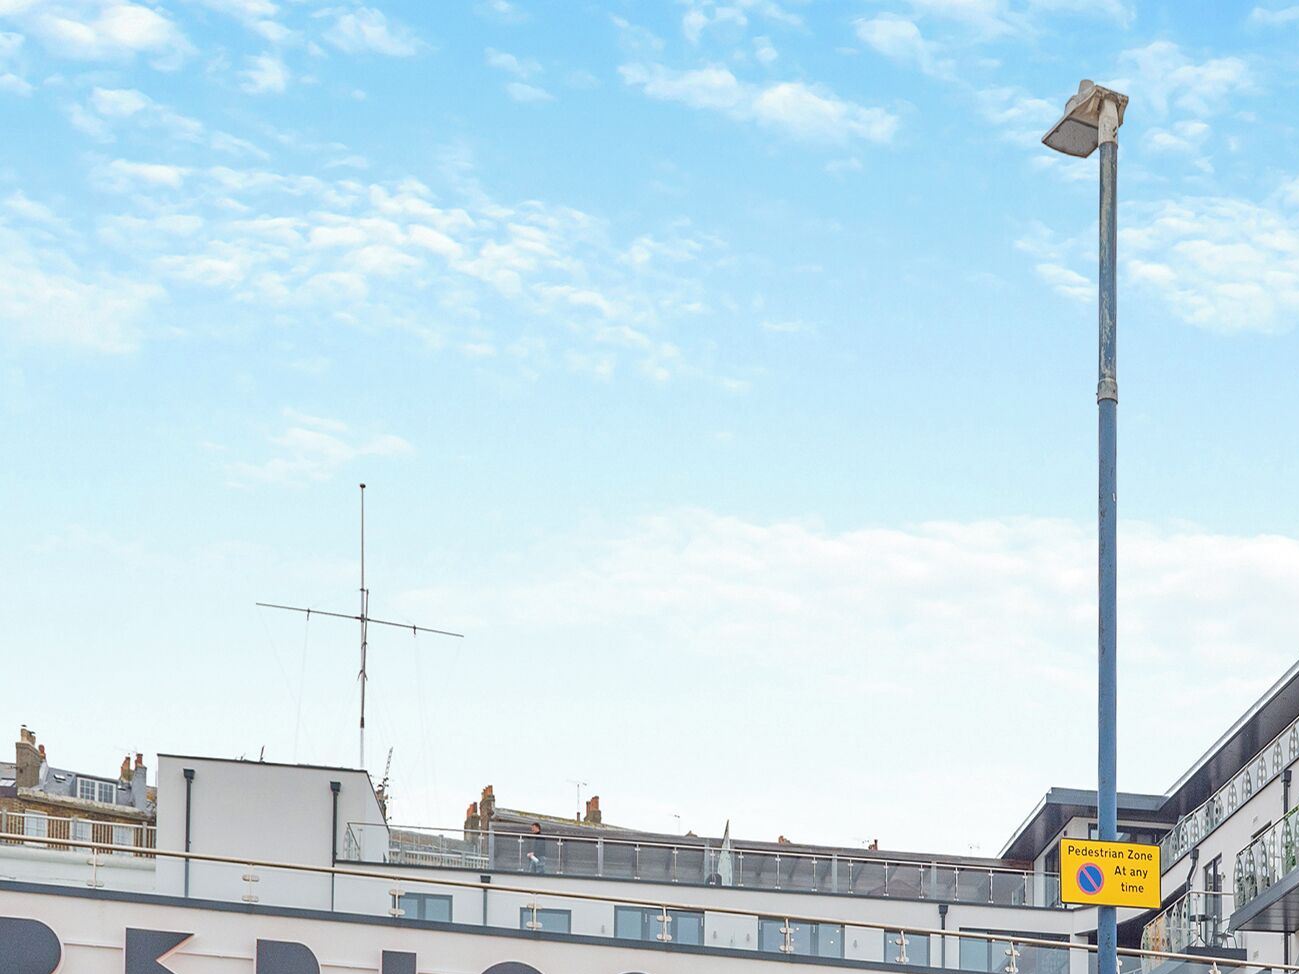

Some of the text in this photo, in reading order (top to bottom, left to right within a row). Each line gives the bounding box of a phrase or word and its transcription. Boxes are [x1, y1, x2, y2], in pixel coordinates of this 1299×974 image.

[1067, 845, 1153, 861] Pedestrian Zone
[1114, 865, 1149, 879] At any
[1120, 882, 1145, 893] time
